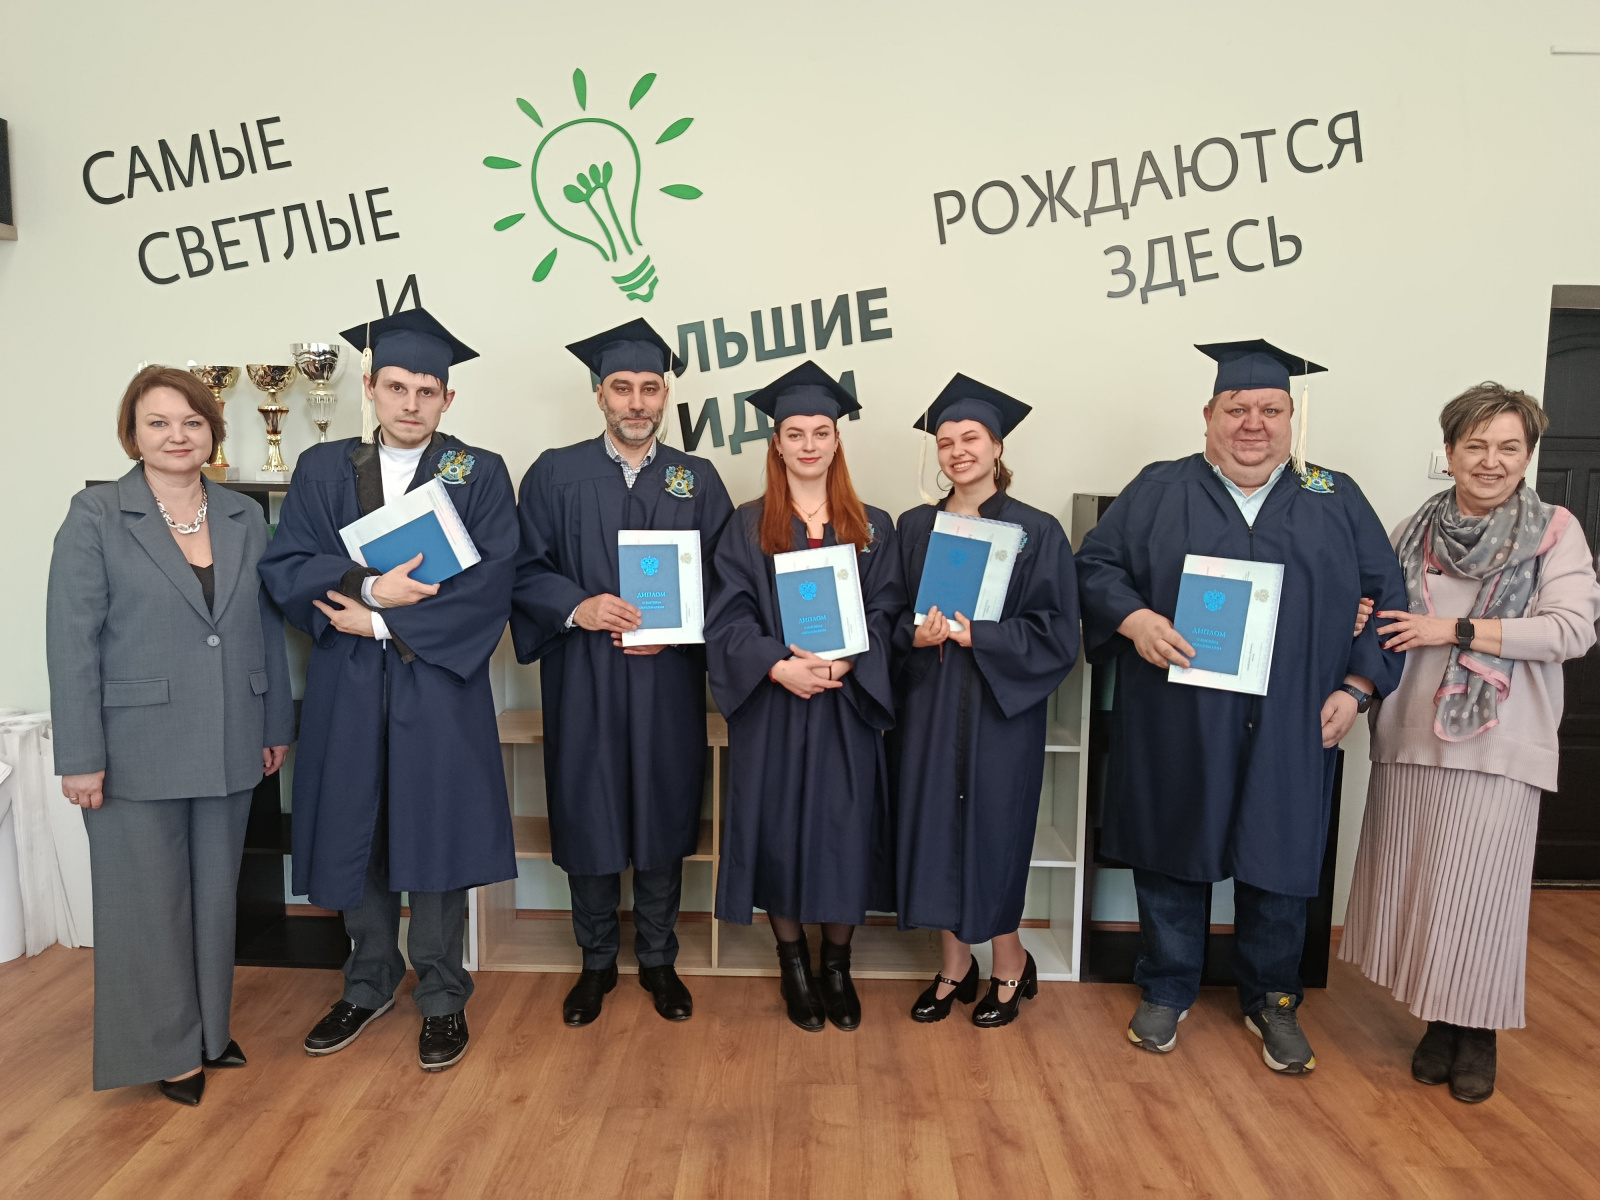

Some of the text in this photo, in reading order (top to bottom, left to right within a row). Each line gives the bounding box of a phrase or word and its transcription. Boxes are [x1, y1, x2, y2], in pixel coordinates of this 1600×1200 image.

[82, 115, 292, 205] САМЫЕ
[933, 110, 1363, 245] РОЖДАЮТСЯ
[137, 186, 400, 285] СВЕТЛЫЕ
[1103, 215, 1303, 305] ЗДЕСЬ
[376, 273, 422, 319] И
[589, 287, 893, 393] ЛЬШИЕ
[677, 370, 861, 456] ИД
[637, 591, 666, 599] ДИПЛОМ
[799, 615, 827, 624] ДИПЛОМ
[1192, 628, 1226, 637] ДИПЛОМ
